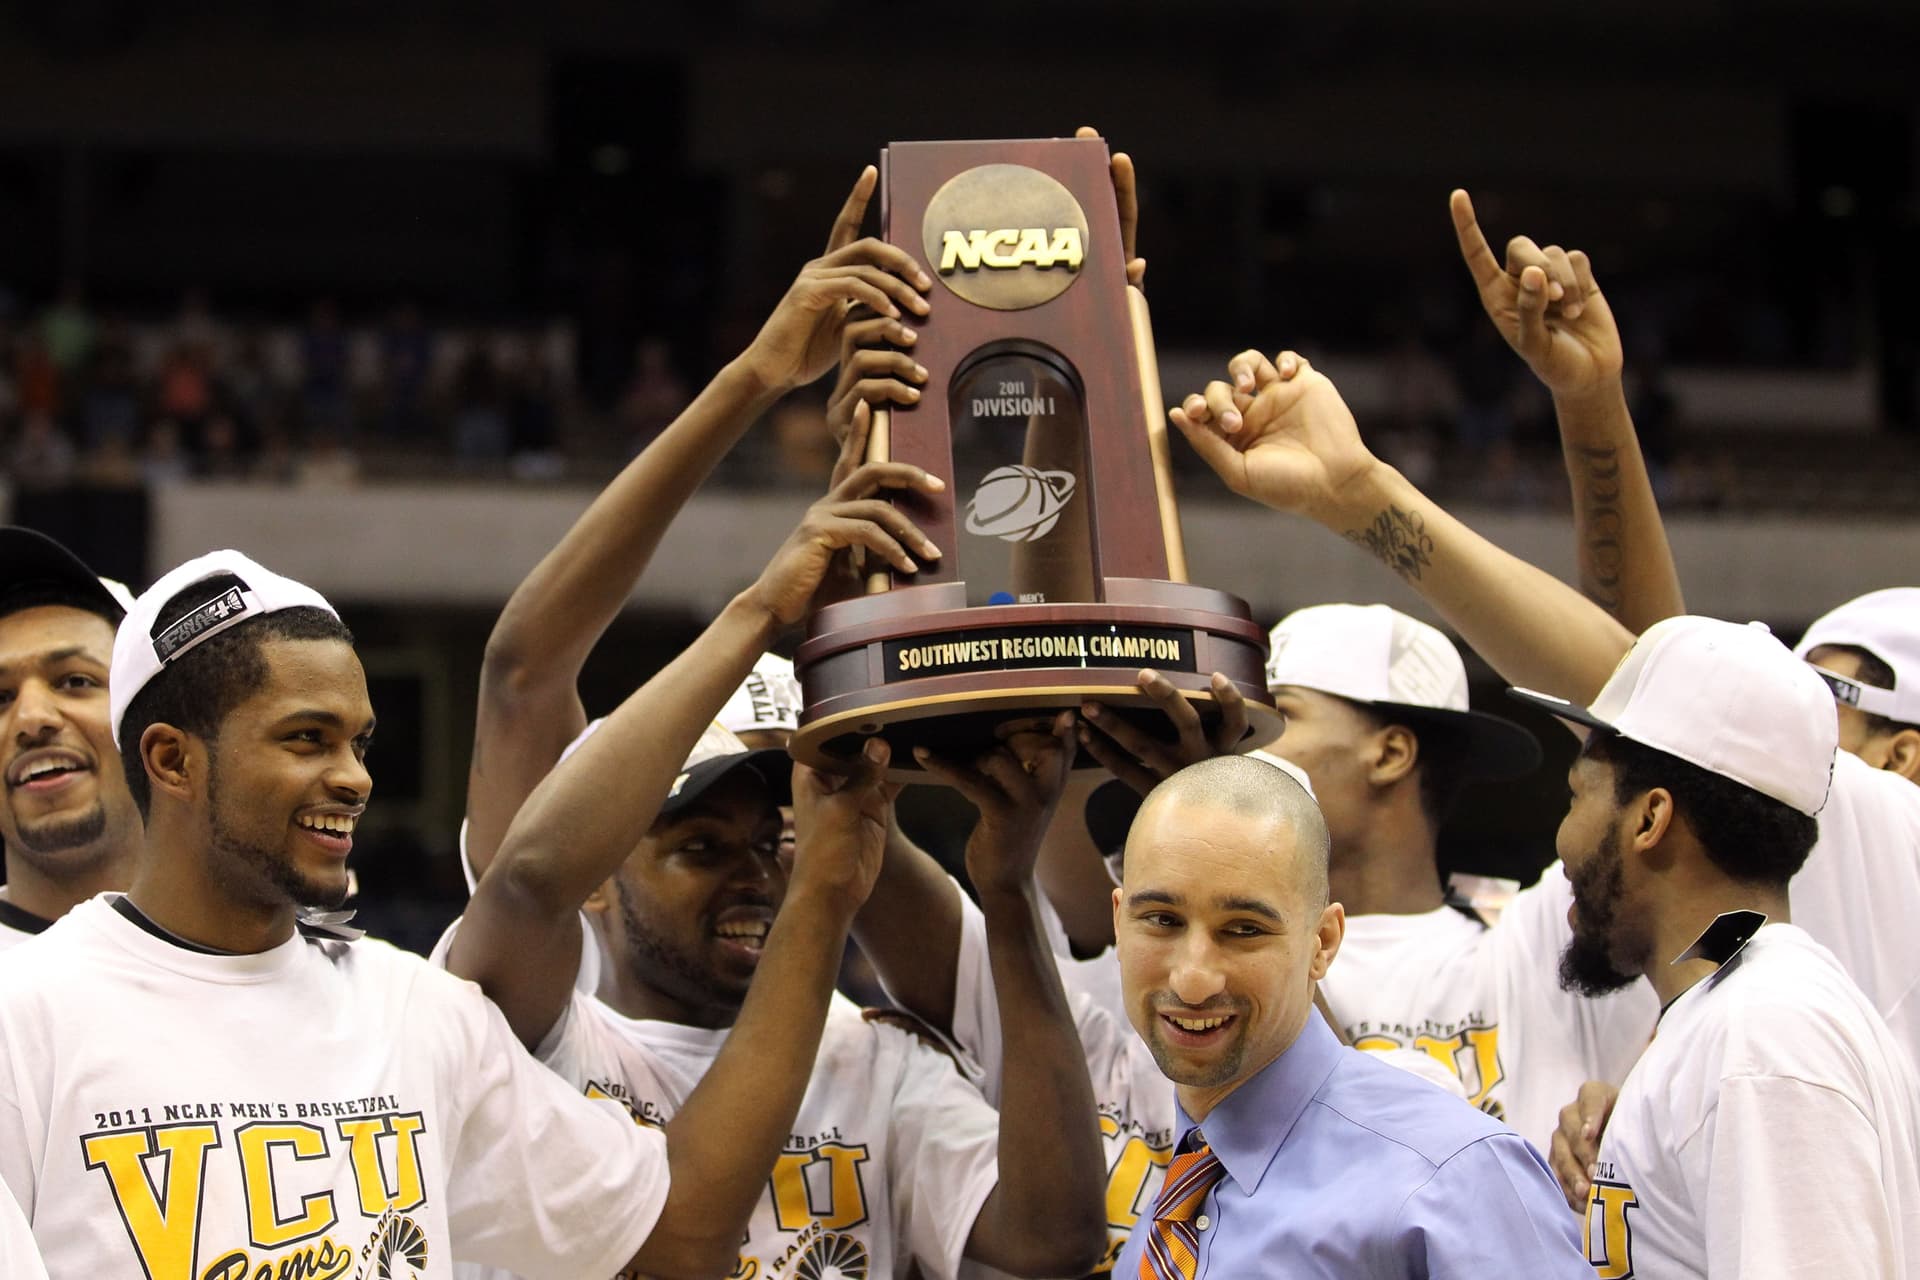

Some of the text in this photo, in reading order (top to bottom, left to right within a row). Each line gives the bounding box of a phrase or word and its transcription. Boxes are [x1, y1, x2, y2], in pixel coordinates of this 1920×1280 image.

[939, 228, 1084, 274] NCAA
[999, 381, 1025, 395] 2011
[972, 397, 1056, 417] DIVISION I
[1019, 592, 1046, 603] MEN'S
[899, 635, 1180, 671] SOUTHWEST REGIONAL CHAMPION
[95, 1107, 152, 1129] 2011
[164, 1103, 223, 1121] NCAA
[230, 1103, 288, 1119] MEN'S
[80, 1112, 428, 1280] VCU
[361, 1204, 394, 1262] RAMS
[772, 1221, 820, 1272] RAMS
